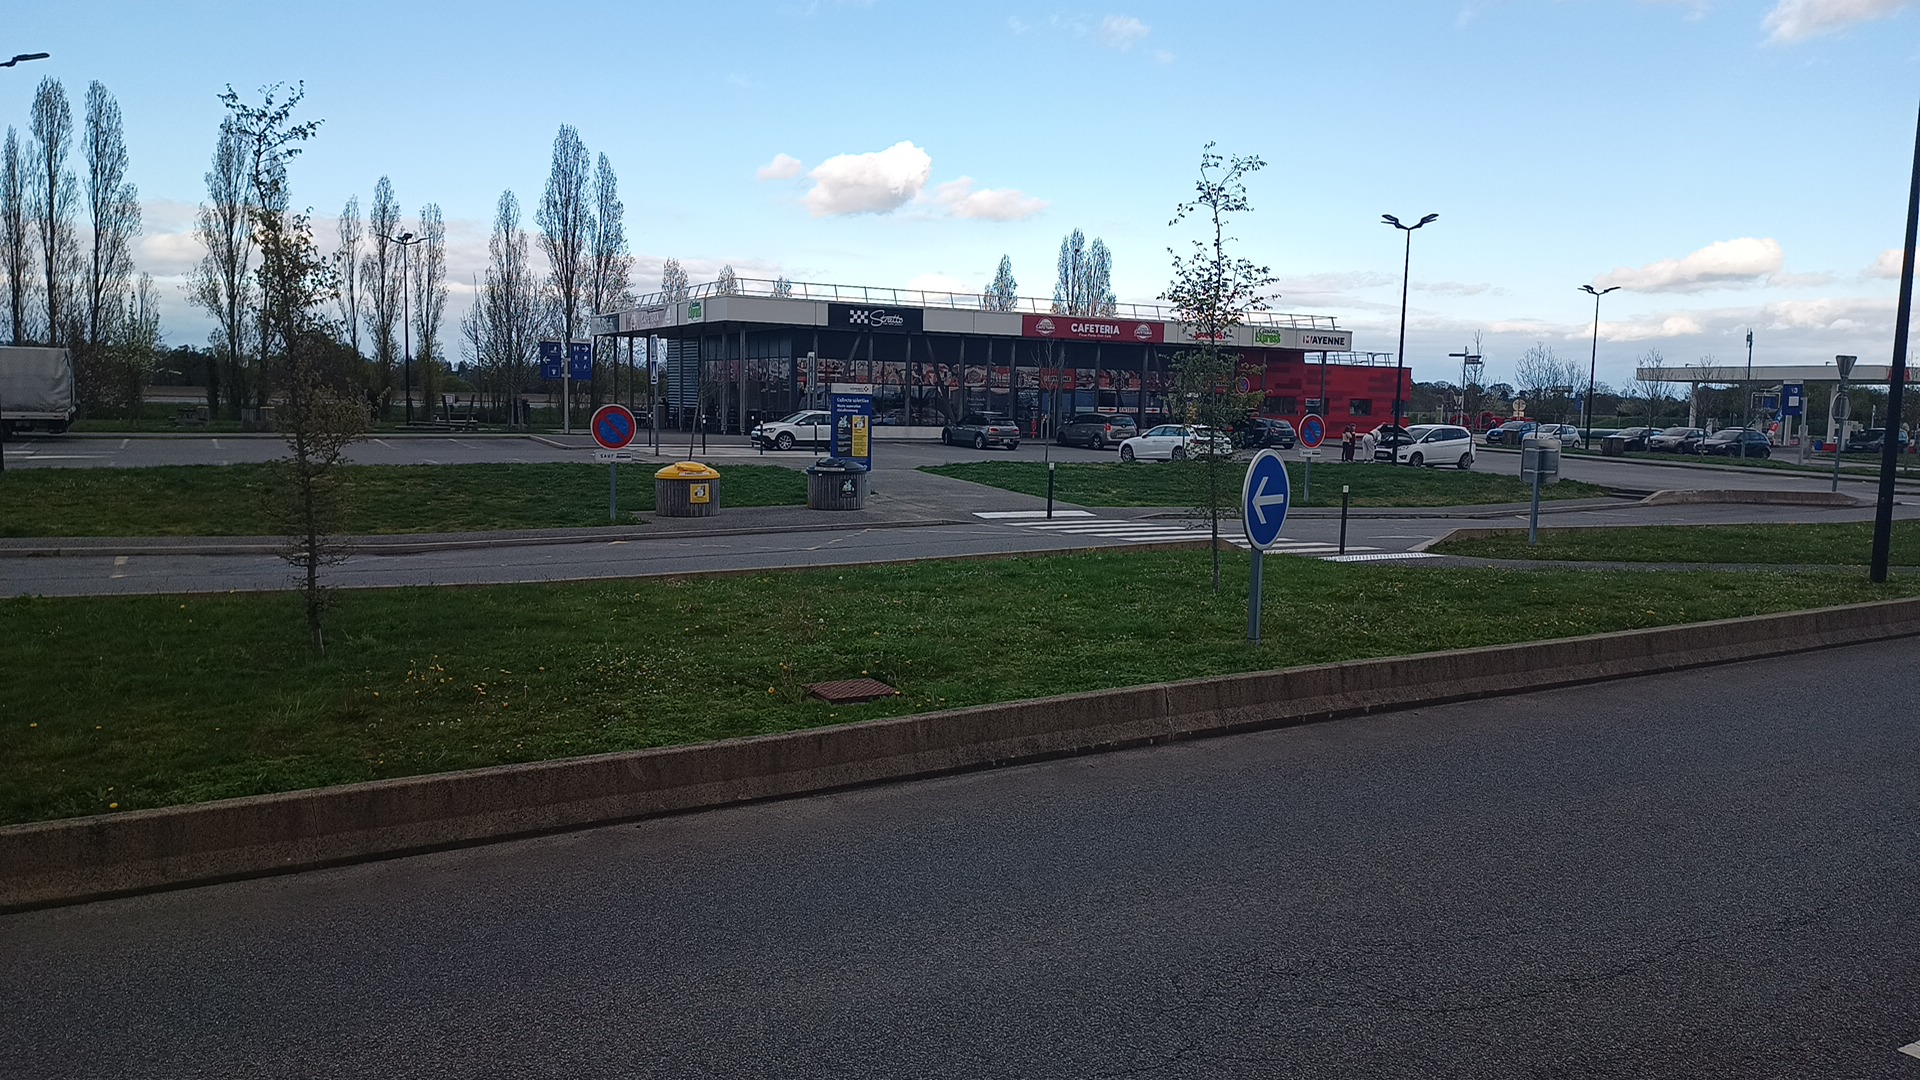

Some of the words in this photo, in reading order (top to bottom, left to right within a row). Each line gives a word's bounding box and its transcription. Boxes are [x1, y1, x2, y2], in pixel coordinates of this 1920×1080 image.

[869, 309, 904, 327] Stretto
[1071, 322, 1120, 335] CAFETERIA
[1302, 335, 1346, 346] MAYENNE
